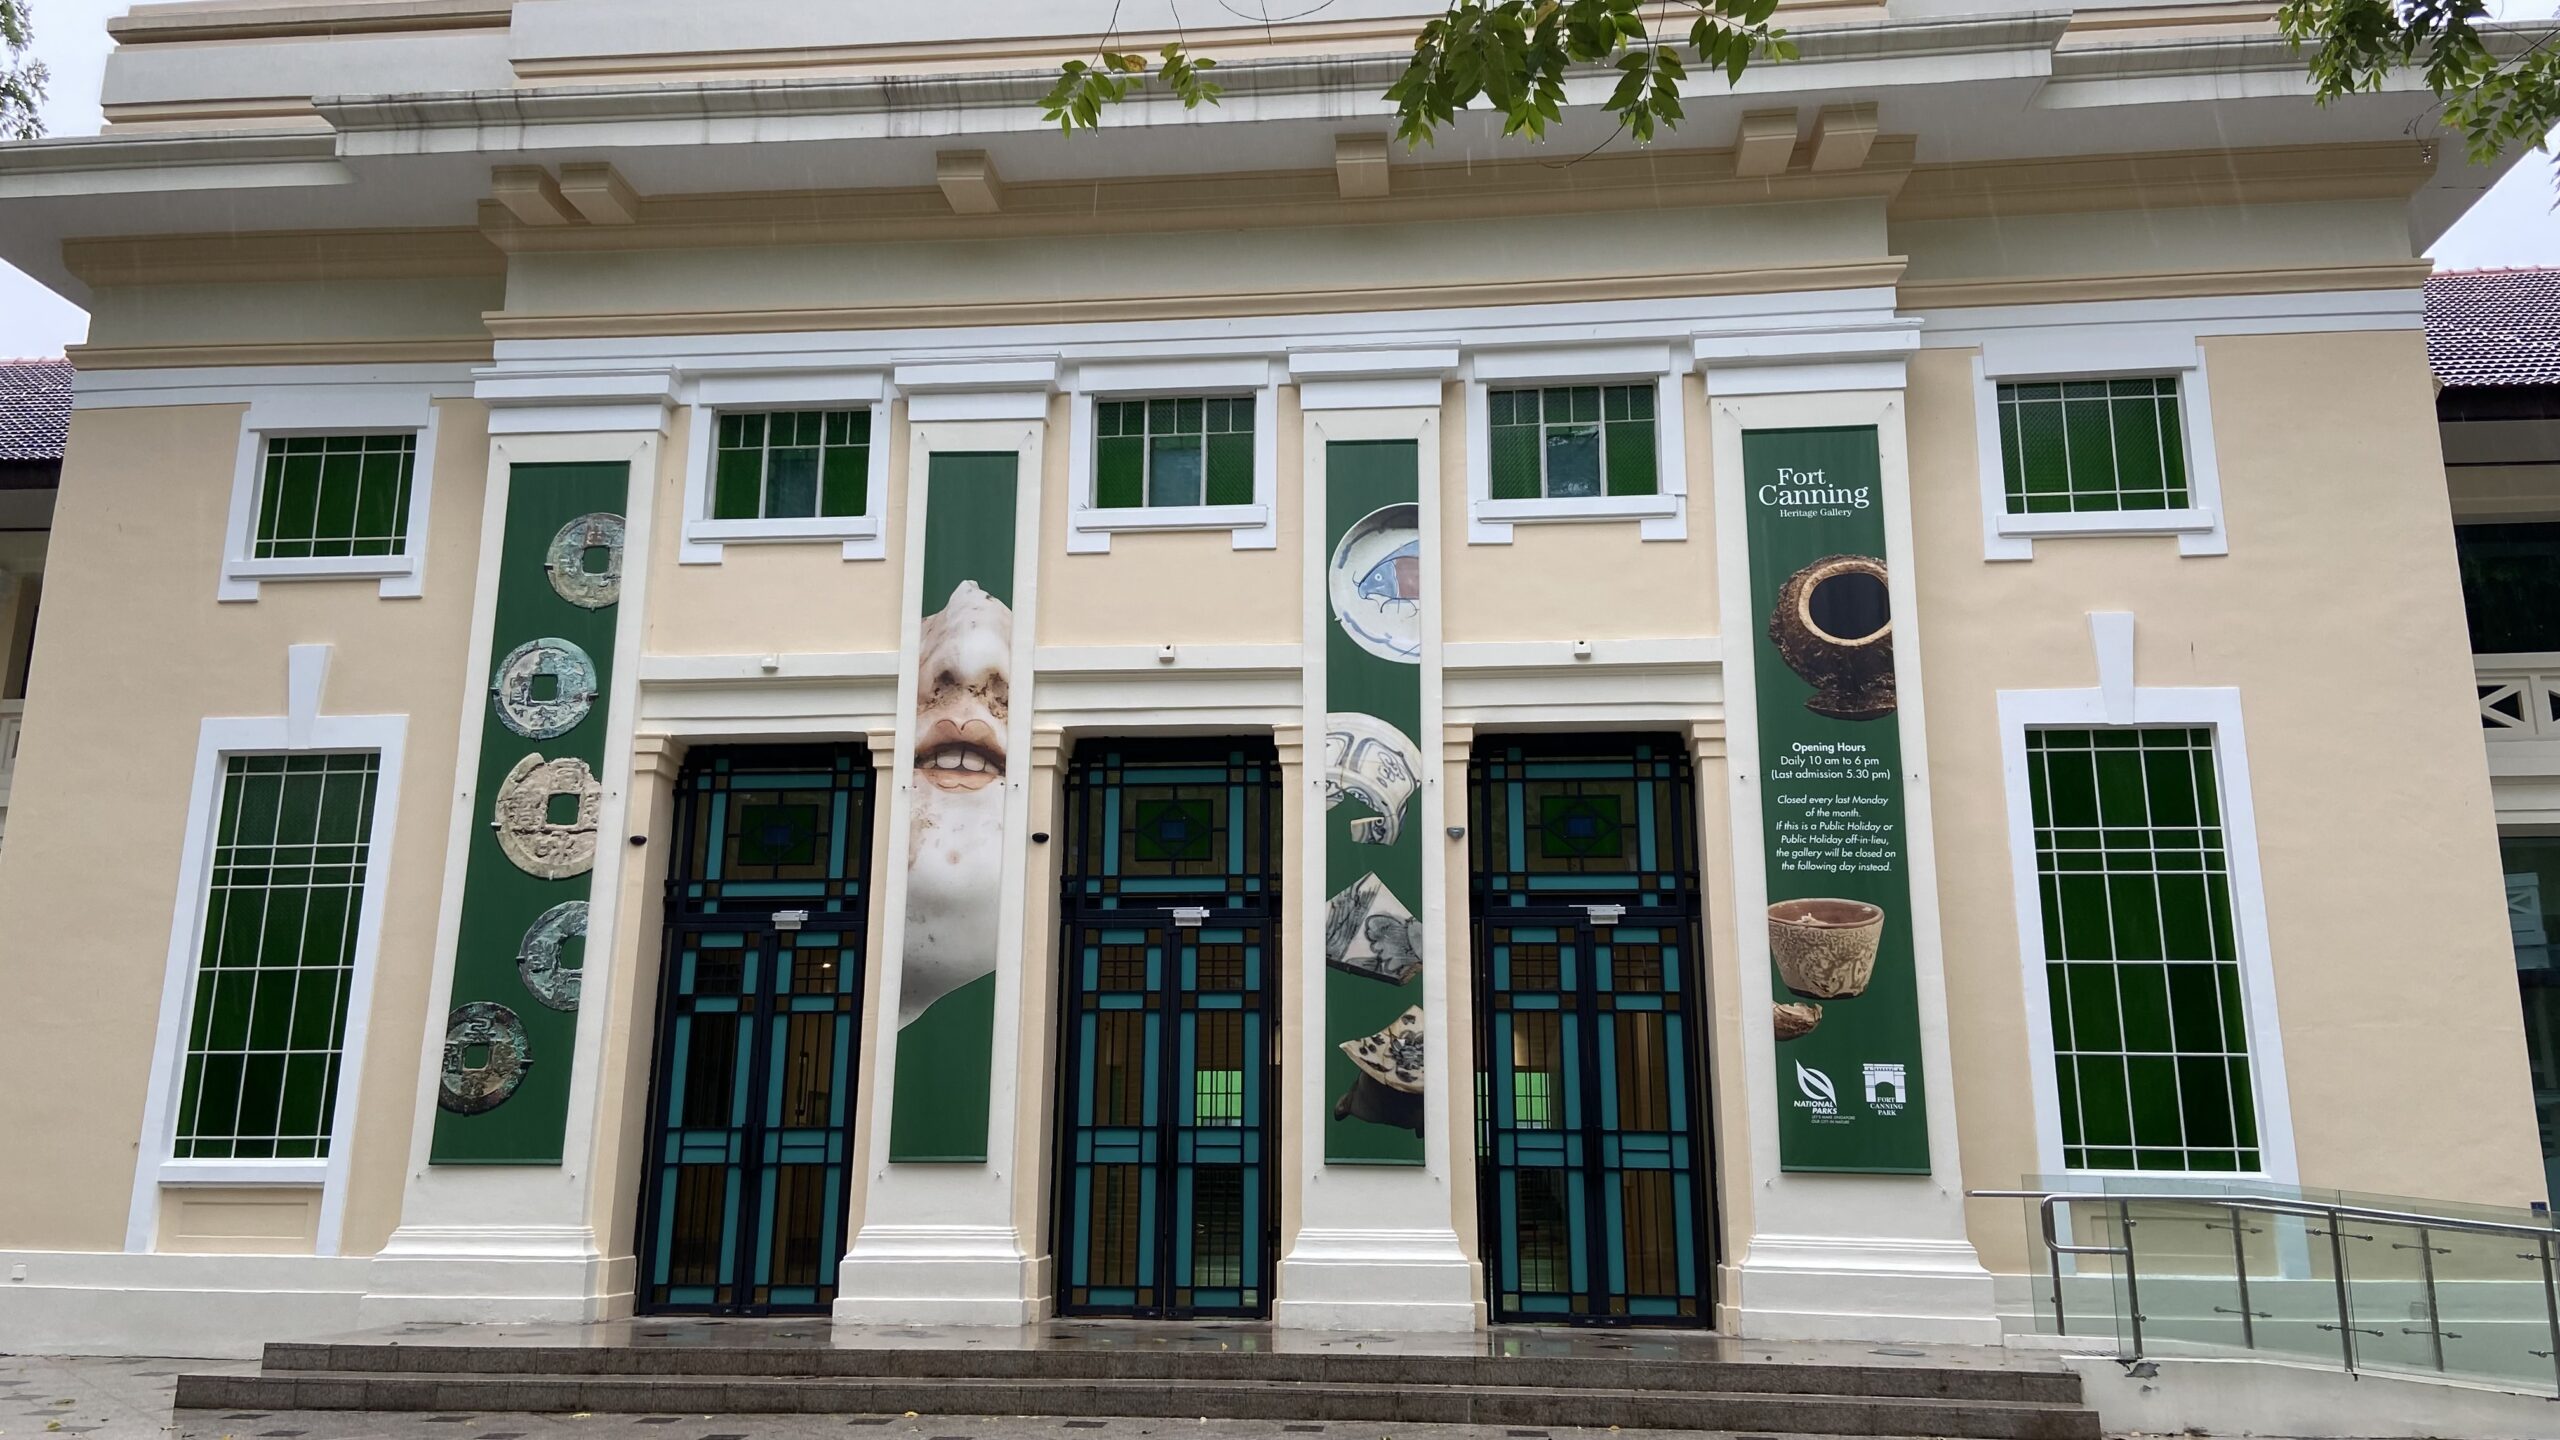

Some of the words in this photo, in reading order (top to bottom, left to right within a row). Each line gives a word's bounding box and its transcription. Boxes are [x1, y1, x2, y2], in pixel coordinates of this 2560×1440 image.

[1777, 467, 1826, 486] Fort
[1758, 483, 1870, 509] Canning
[1780, 509, 1818, 518] Heritage
[1820, 508, 1852, 518] Gallery
[1792, 742, 1834, 754] Opening
[1838, 742, 1866, 752] Hours
[1780, 756, 1805, 767] Daily
[1810, 756, 1821, 765] 10
[1843, 756, 1851, 764] to
[1855, 756, 1861, 764] 6
[1865, 758, 1879, 767] pm
[1771, 769, 1792, 780] (Last
[1795, 768, 1842, 778] admission
[1846, 769, 1869, 778] 5.30
[1872, 769, 1890, 780] pm)
[1777, 795, 1806, 804] Closed
[1809, 797, 1833, 806] every
[1835, 795, 1850, 804] last
[1852, 795, 1888, 806] Monday
[1806, 808, 1816, 817] of
[1816, 808, 1830, 817] the
[1832, 808, 1861, 817] month.
[1776, 822, 1784, 830] If
[1784, 822, 1798, 830] this
[1802, 822, 1808, 830] is
[1820, 822, 1844, 830] Public
[1847, 822, 1881, 833] Holiday
[1781, 835, 1806, 844] Public
[1810, 835, 1843, 845] Holiday
[1845, 835, 1889, 845] off-in-lieu,
[1776, 848, 1789, 857] the
[1792, 848, 1822, 859] gallery
[1824, 848, 1839, 857] will
[1842, 848, 1852, 857] be
[1855, 848, 1882, 858] closed
[1782, 861, 1795, 870] the
[1797, 861, 1836, 873] following
[1839, 862, 1856, 873] day
[1858, 862, 1892, 871] instead.
